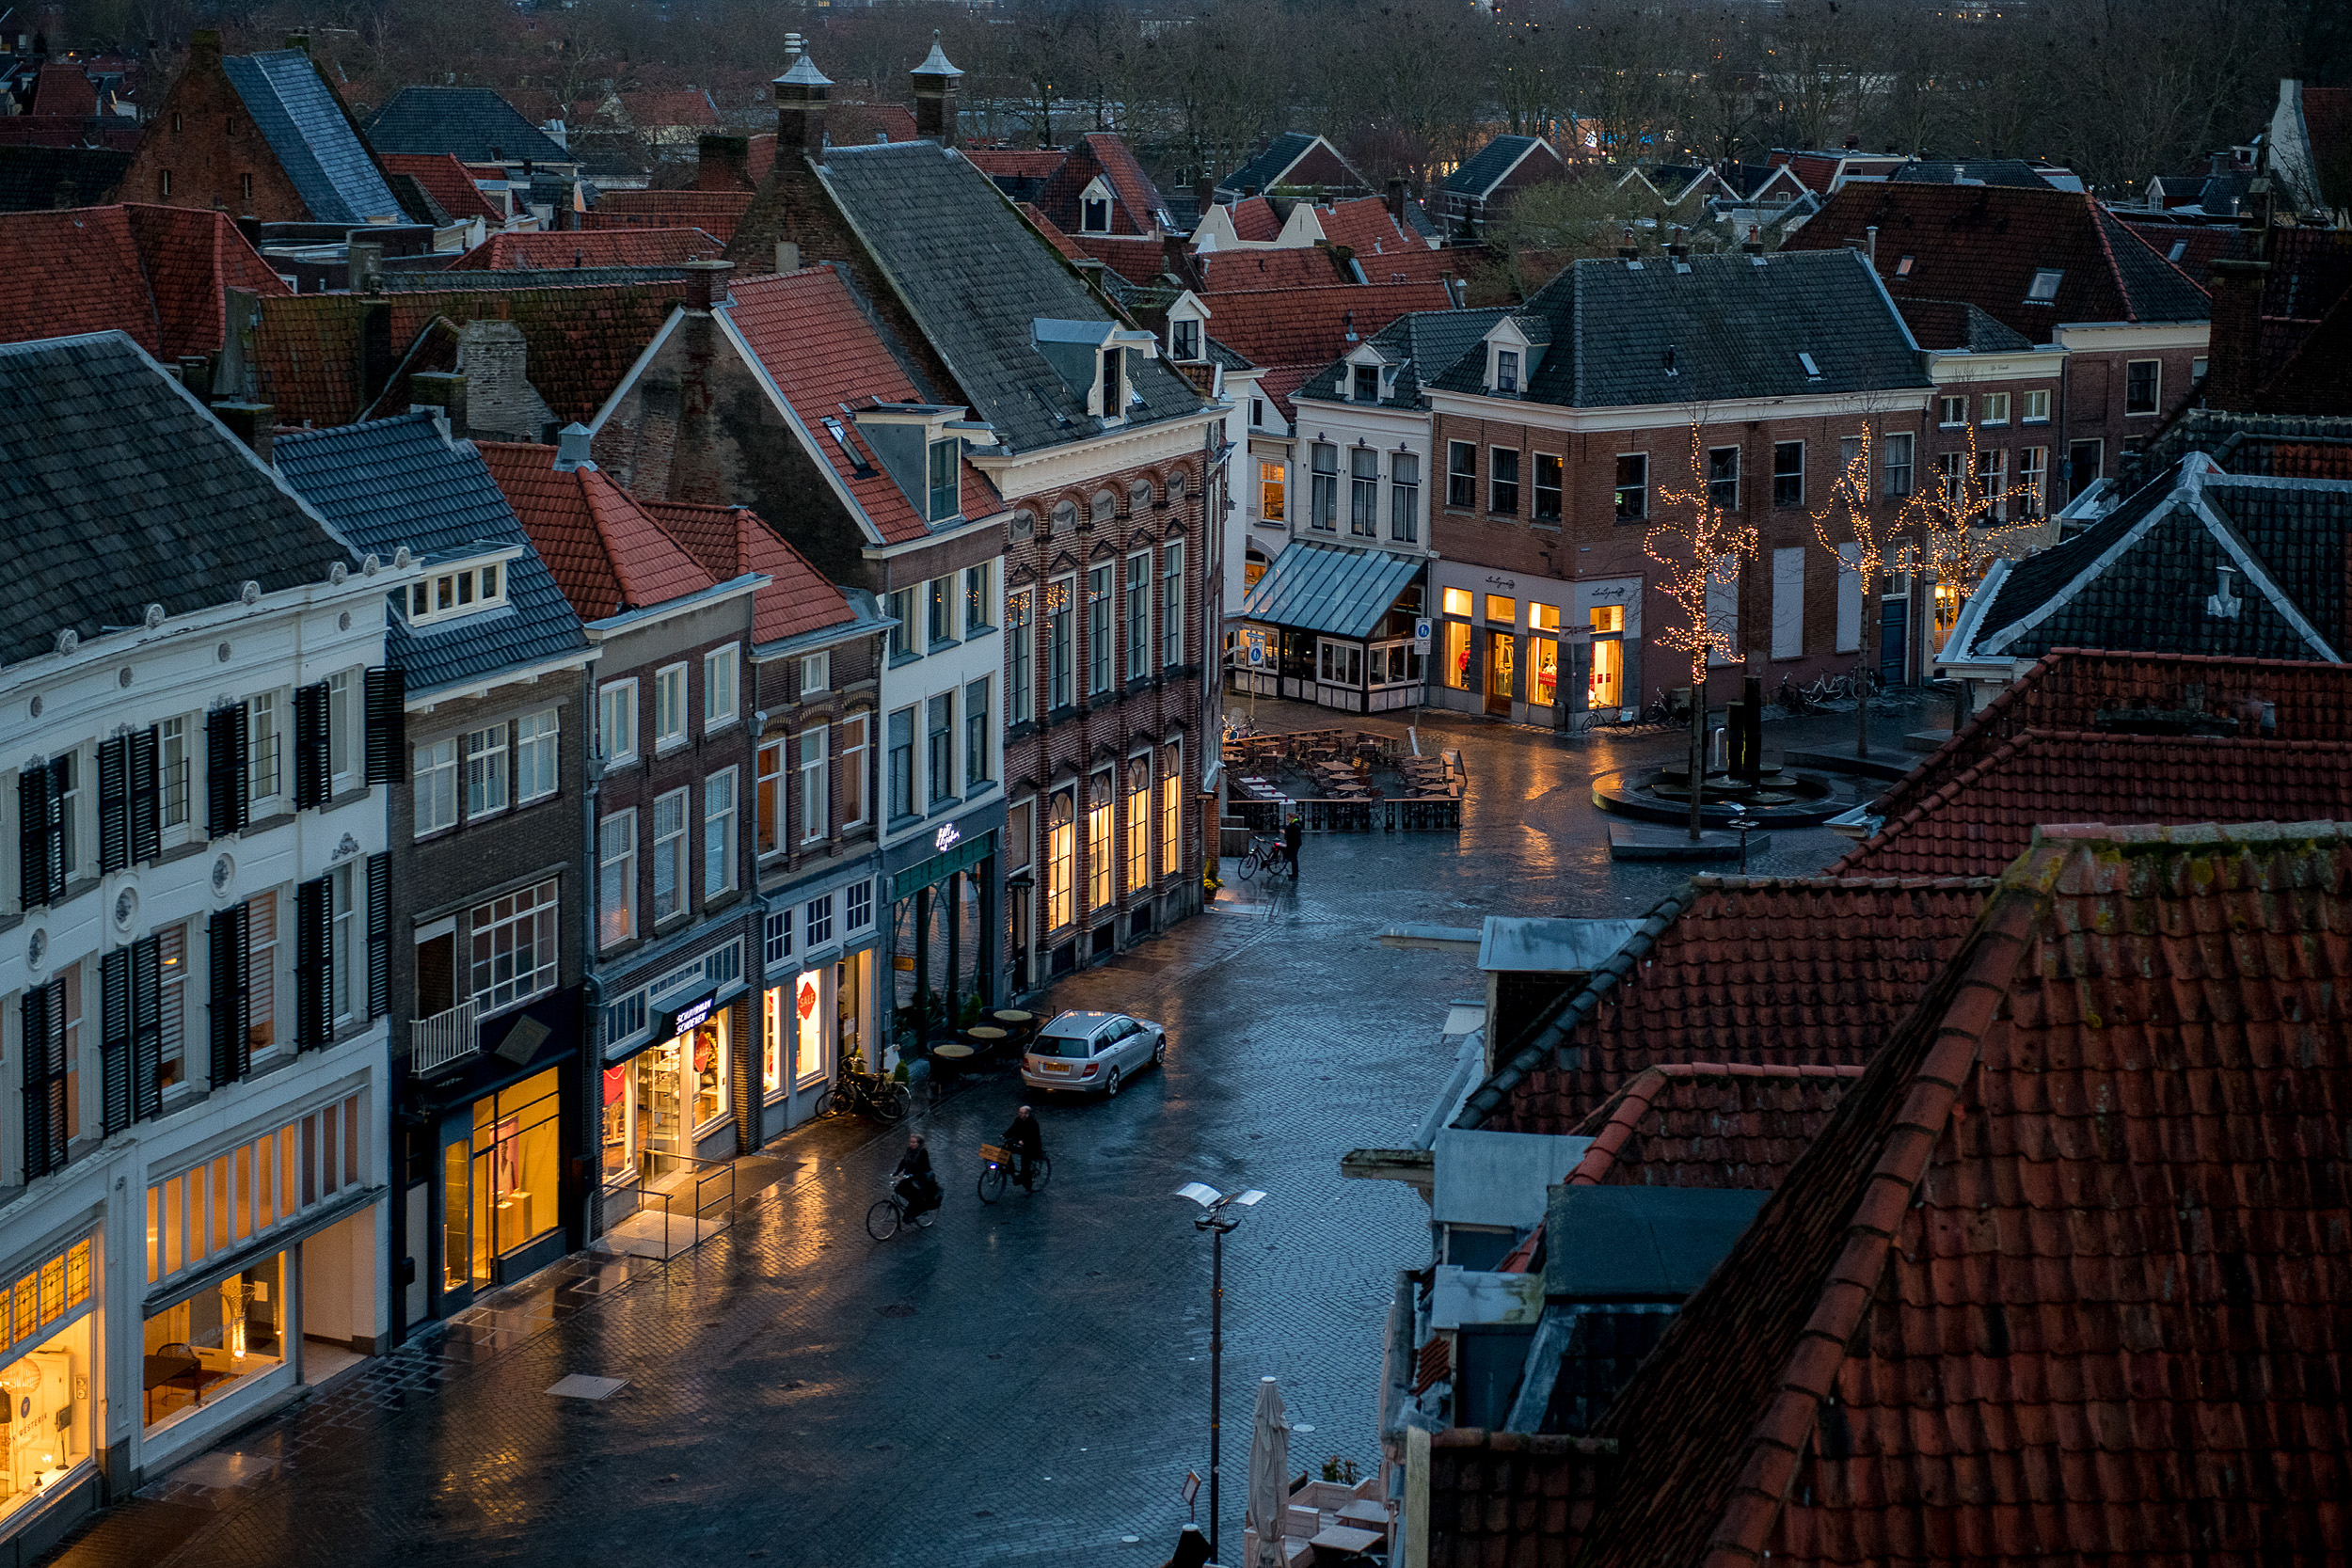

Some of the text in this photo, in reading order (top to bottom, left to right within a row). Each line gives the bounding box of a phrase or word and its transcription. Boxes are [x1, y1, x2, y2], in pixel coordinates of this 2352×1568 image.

[799, 992, 815, 1008] SALE
[695, 1044, 708, 1061] SALE
[19, 1412, 47, 1437] WESTERIK
